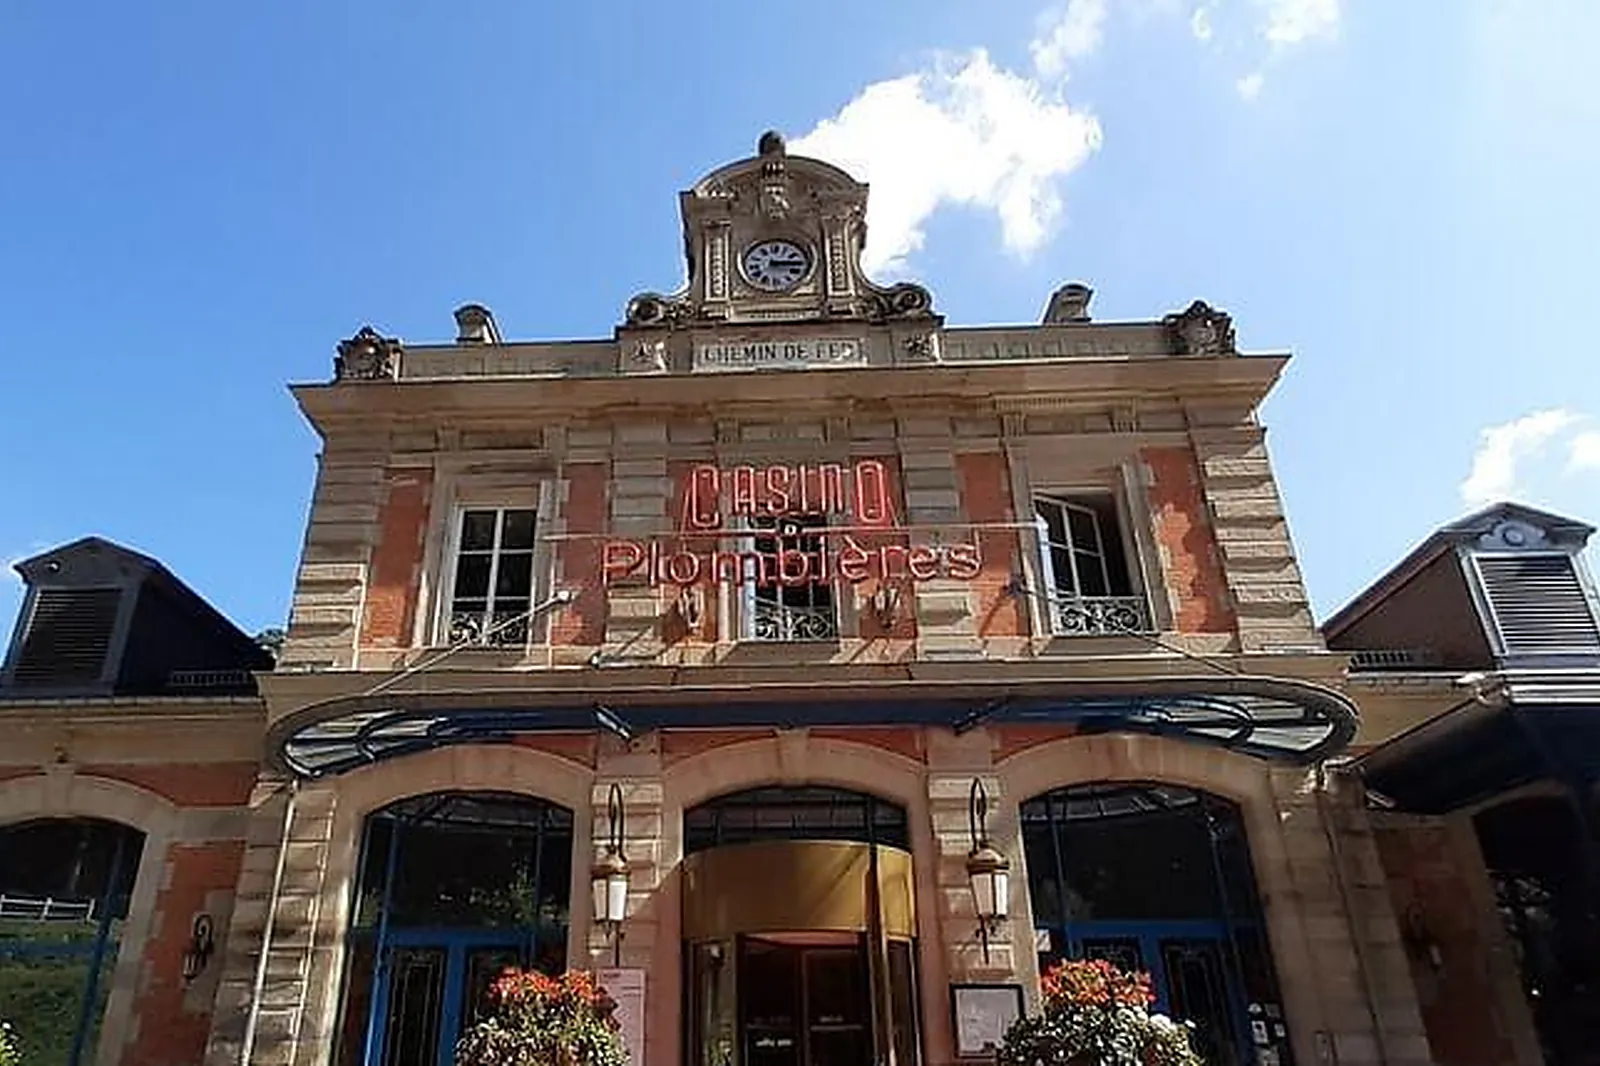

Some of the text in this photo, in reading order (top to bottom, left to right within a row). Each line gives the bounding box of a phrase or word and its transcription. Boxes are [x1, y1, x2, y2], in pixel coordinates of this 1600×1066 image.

[704, 344, 776, 362] CHEMIN
[784, 344, 809, 360] DE
[691, 461, 886, 528] CASINO
[601, 533, 982, 587] Plombières
